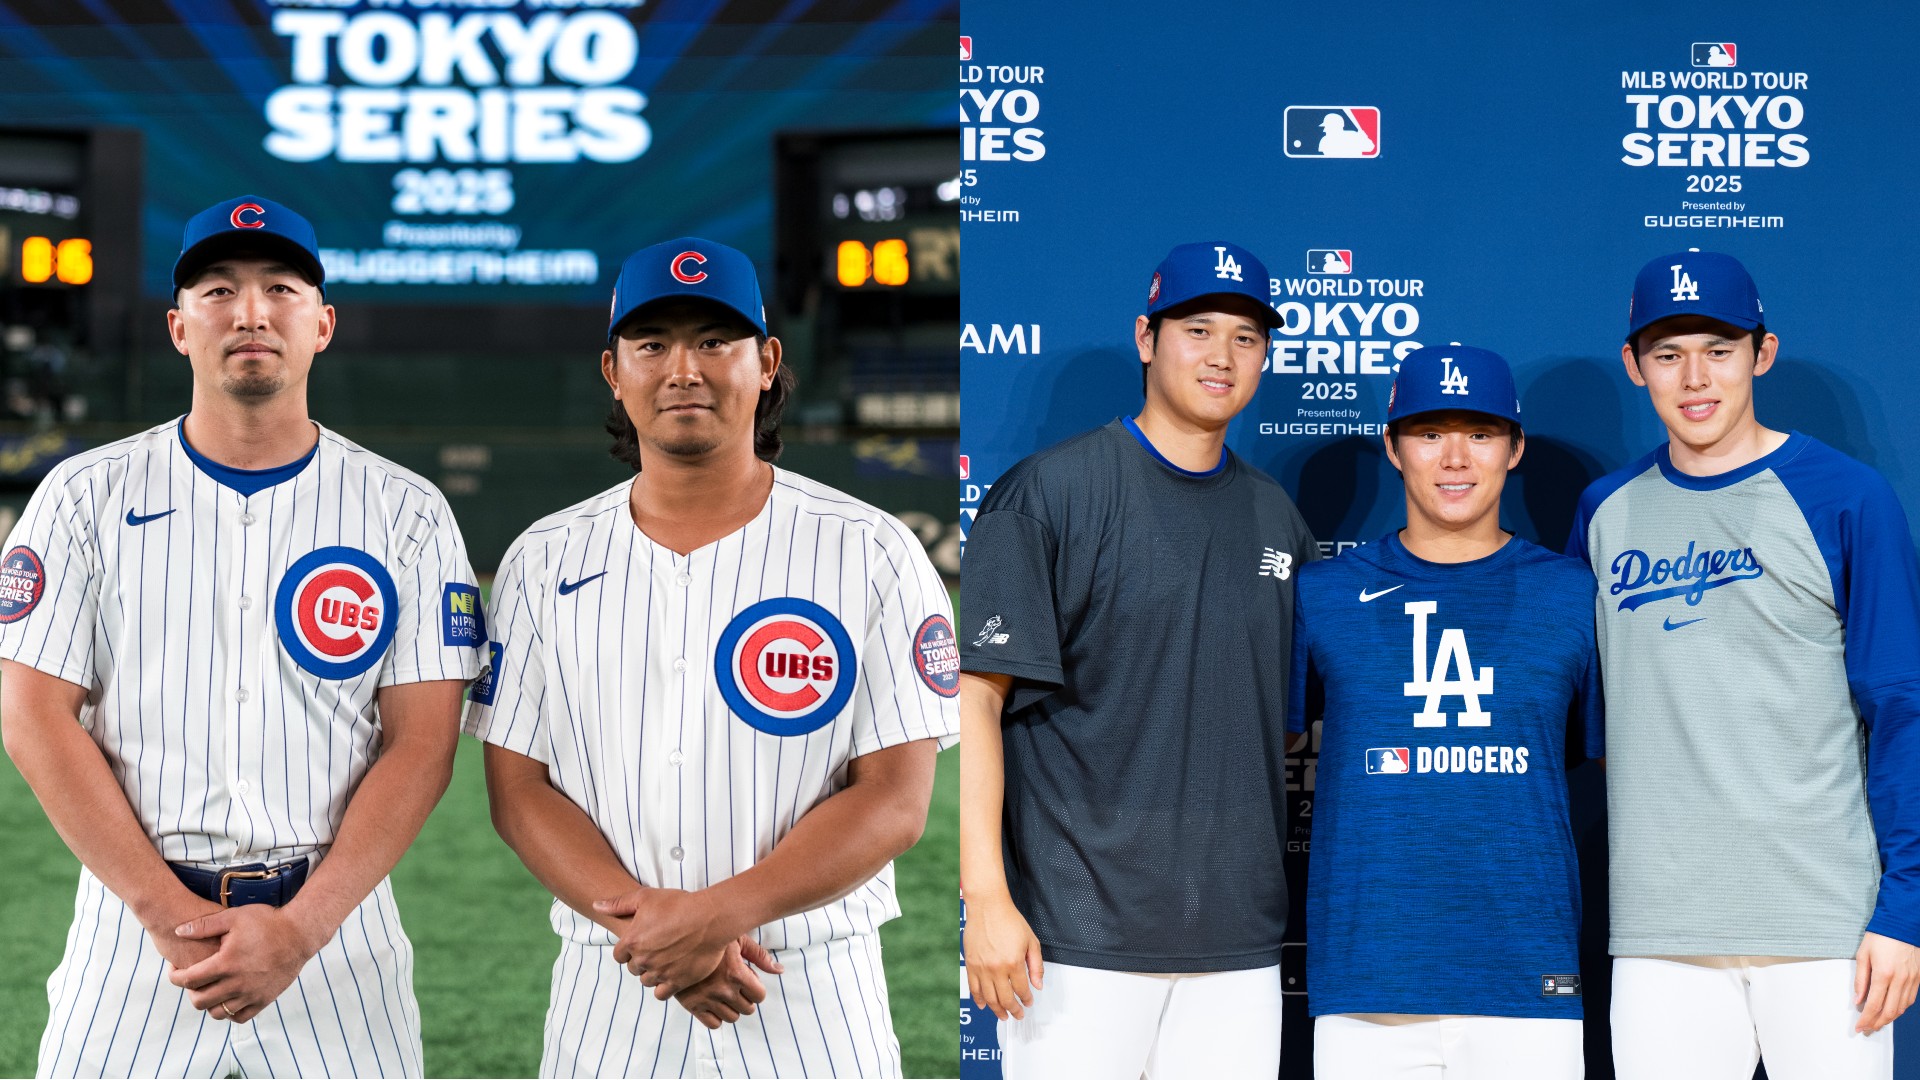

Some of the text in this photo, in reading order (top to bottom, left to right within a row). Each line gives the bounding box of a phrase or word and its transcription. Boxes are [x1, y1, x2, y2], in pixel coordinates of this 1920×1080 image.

[272, 9, 640, 86] TOKYO
[987, 66, 1044, 83] TOUR
[1621, 71, 1809, 90] MLB WORLD TOUR
[262, 84, 652, 163] SERIES
[1626, 94, 1804, 129] TOKYO
[1621, 132, 1810, 167] SERIES
[391, 168, 515, 214] 2025
[1686, 175, 1742, 193] 2025
[230, 203, 265, 228] C
[969, 195, 981, 206] by
[1682, 201, 1745, 212] Presented by
[1644, 215, 1784, 228] GUGGENHEIM
[670, 251, 708, 284] C
[1214, 246, 1243, 282] LA
[1288, 279, 1362, 296] WORLD
[1367, 279, 1424, 297] TOUR
[1670, 264, 1700, 301] LA
[1271, 301, 1420, 337] OKYO
[1262, 340, 1424, 374] ERIE
[1301, 382, 1358, 400] 2025
[1440, 358, 1469, 395] LA
[1297, 408, 1361, 419] Presented by
[1610, 540, 1764, 607] Dodgers
[923, 645, 956, 663] TOKYO
[925, 657, 960, 675] SERIES
[1404, 601, 1494, 728] LA
[1417, 745, 1529, 774] DODGERS
